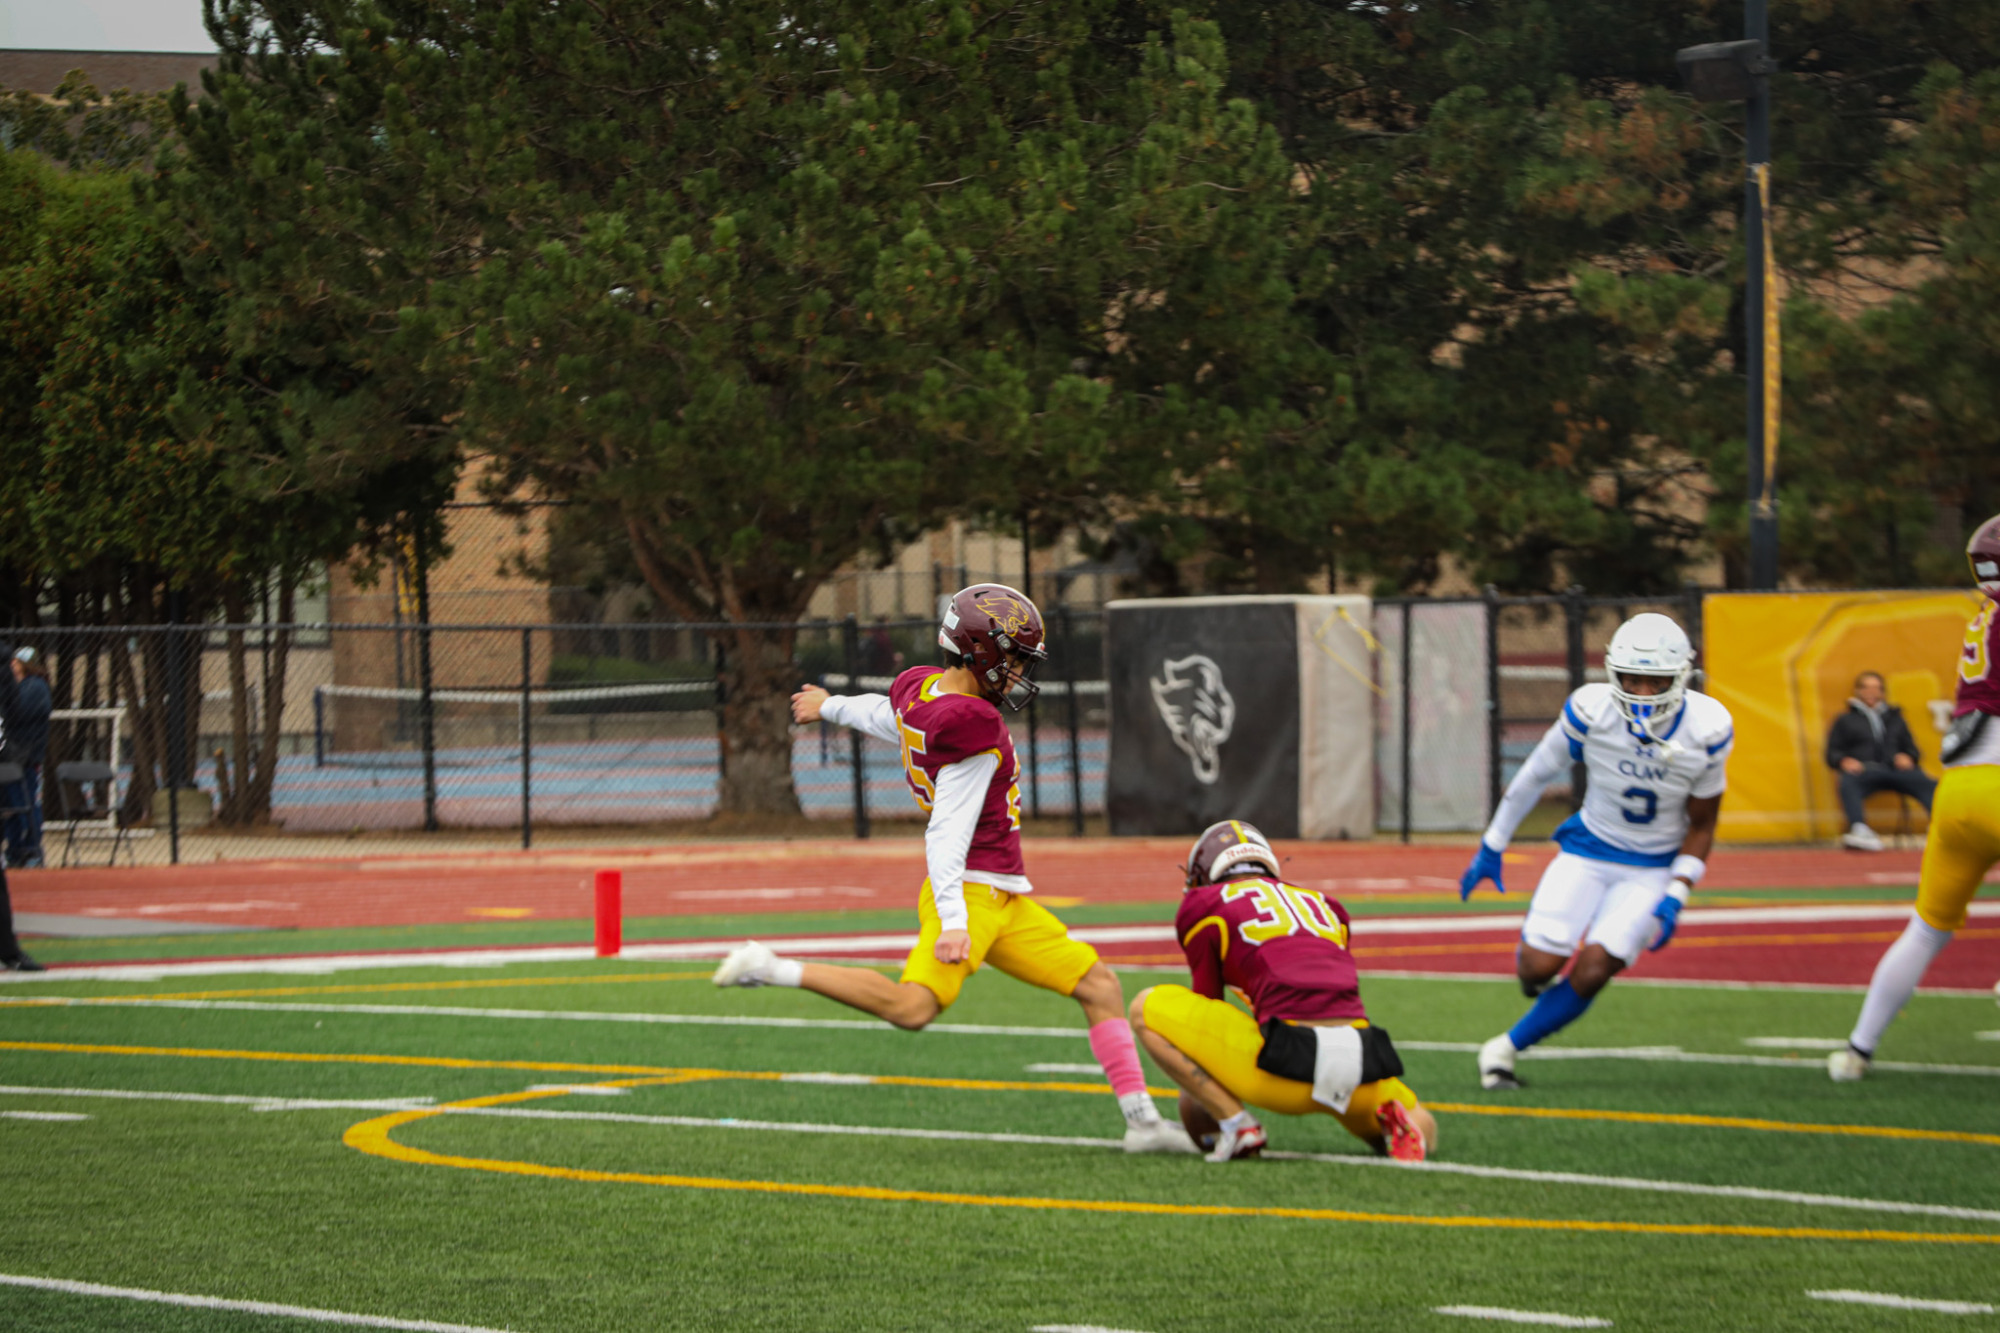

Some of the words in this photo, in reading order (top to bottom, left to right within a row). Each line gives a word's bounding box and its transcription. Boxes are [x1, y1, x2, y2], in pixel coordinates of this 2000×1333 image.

[895, 708, 936, 818] 5
[1622, 787, 1658, 824] 3
[1220, 878, 1345, 949] 30
